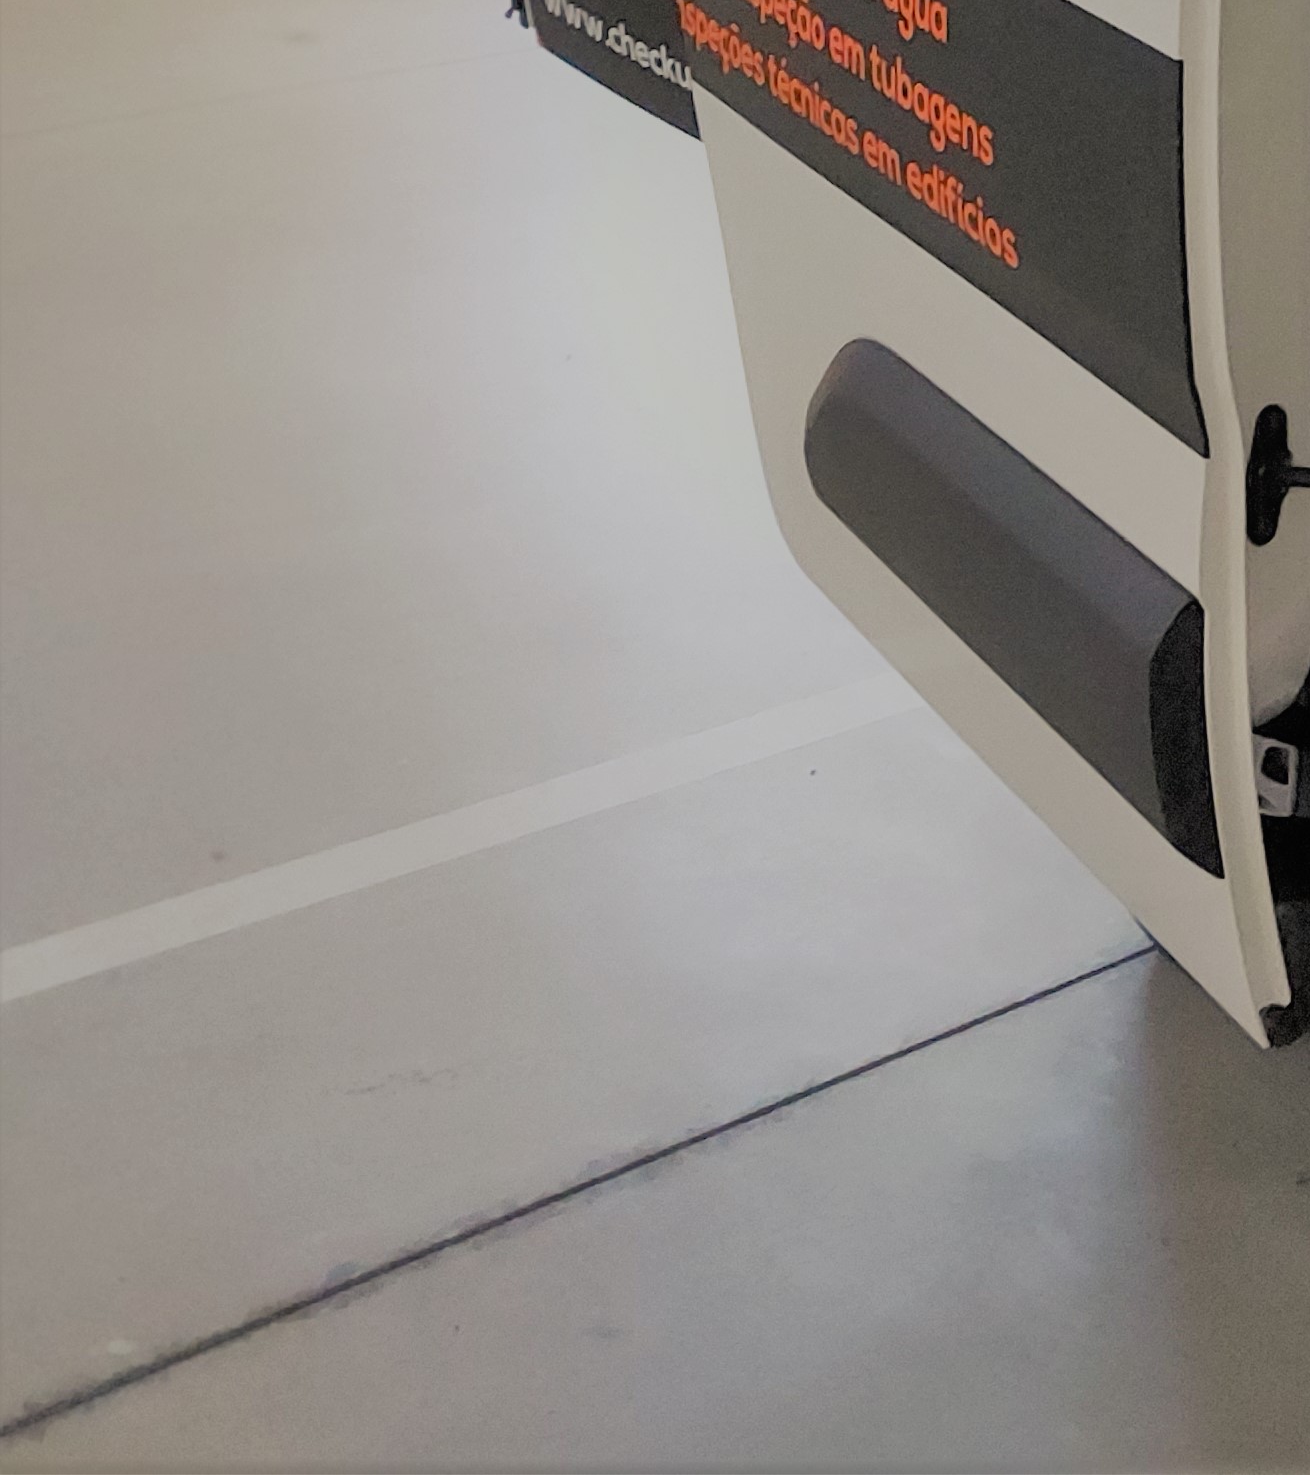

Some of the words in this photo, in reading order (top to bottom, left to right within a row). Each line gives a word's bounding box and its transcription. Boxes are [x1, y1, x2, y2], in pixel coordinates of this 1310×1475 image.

[766, 52, 860, 156] técnicas
[862, 129, 902, 186] em
[906, 159, 1019, 269] edifícios
[828, 25, 866, 81] em
[870, 44, 994, 166] tubagens
